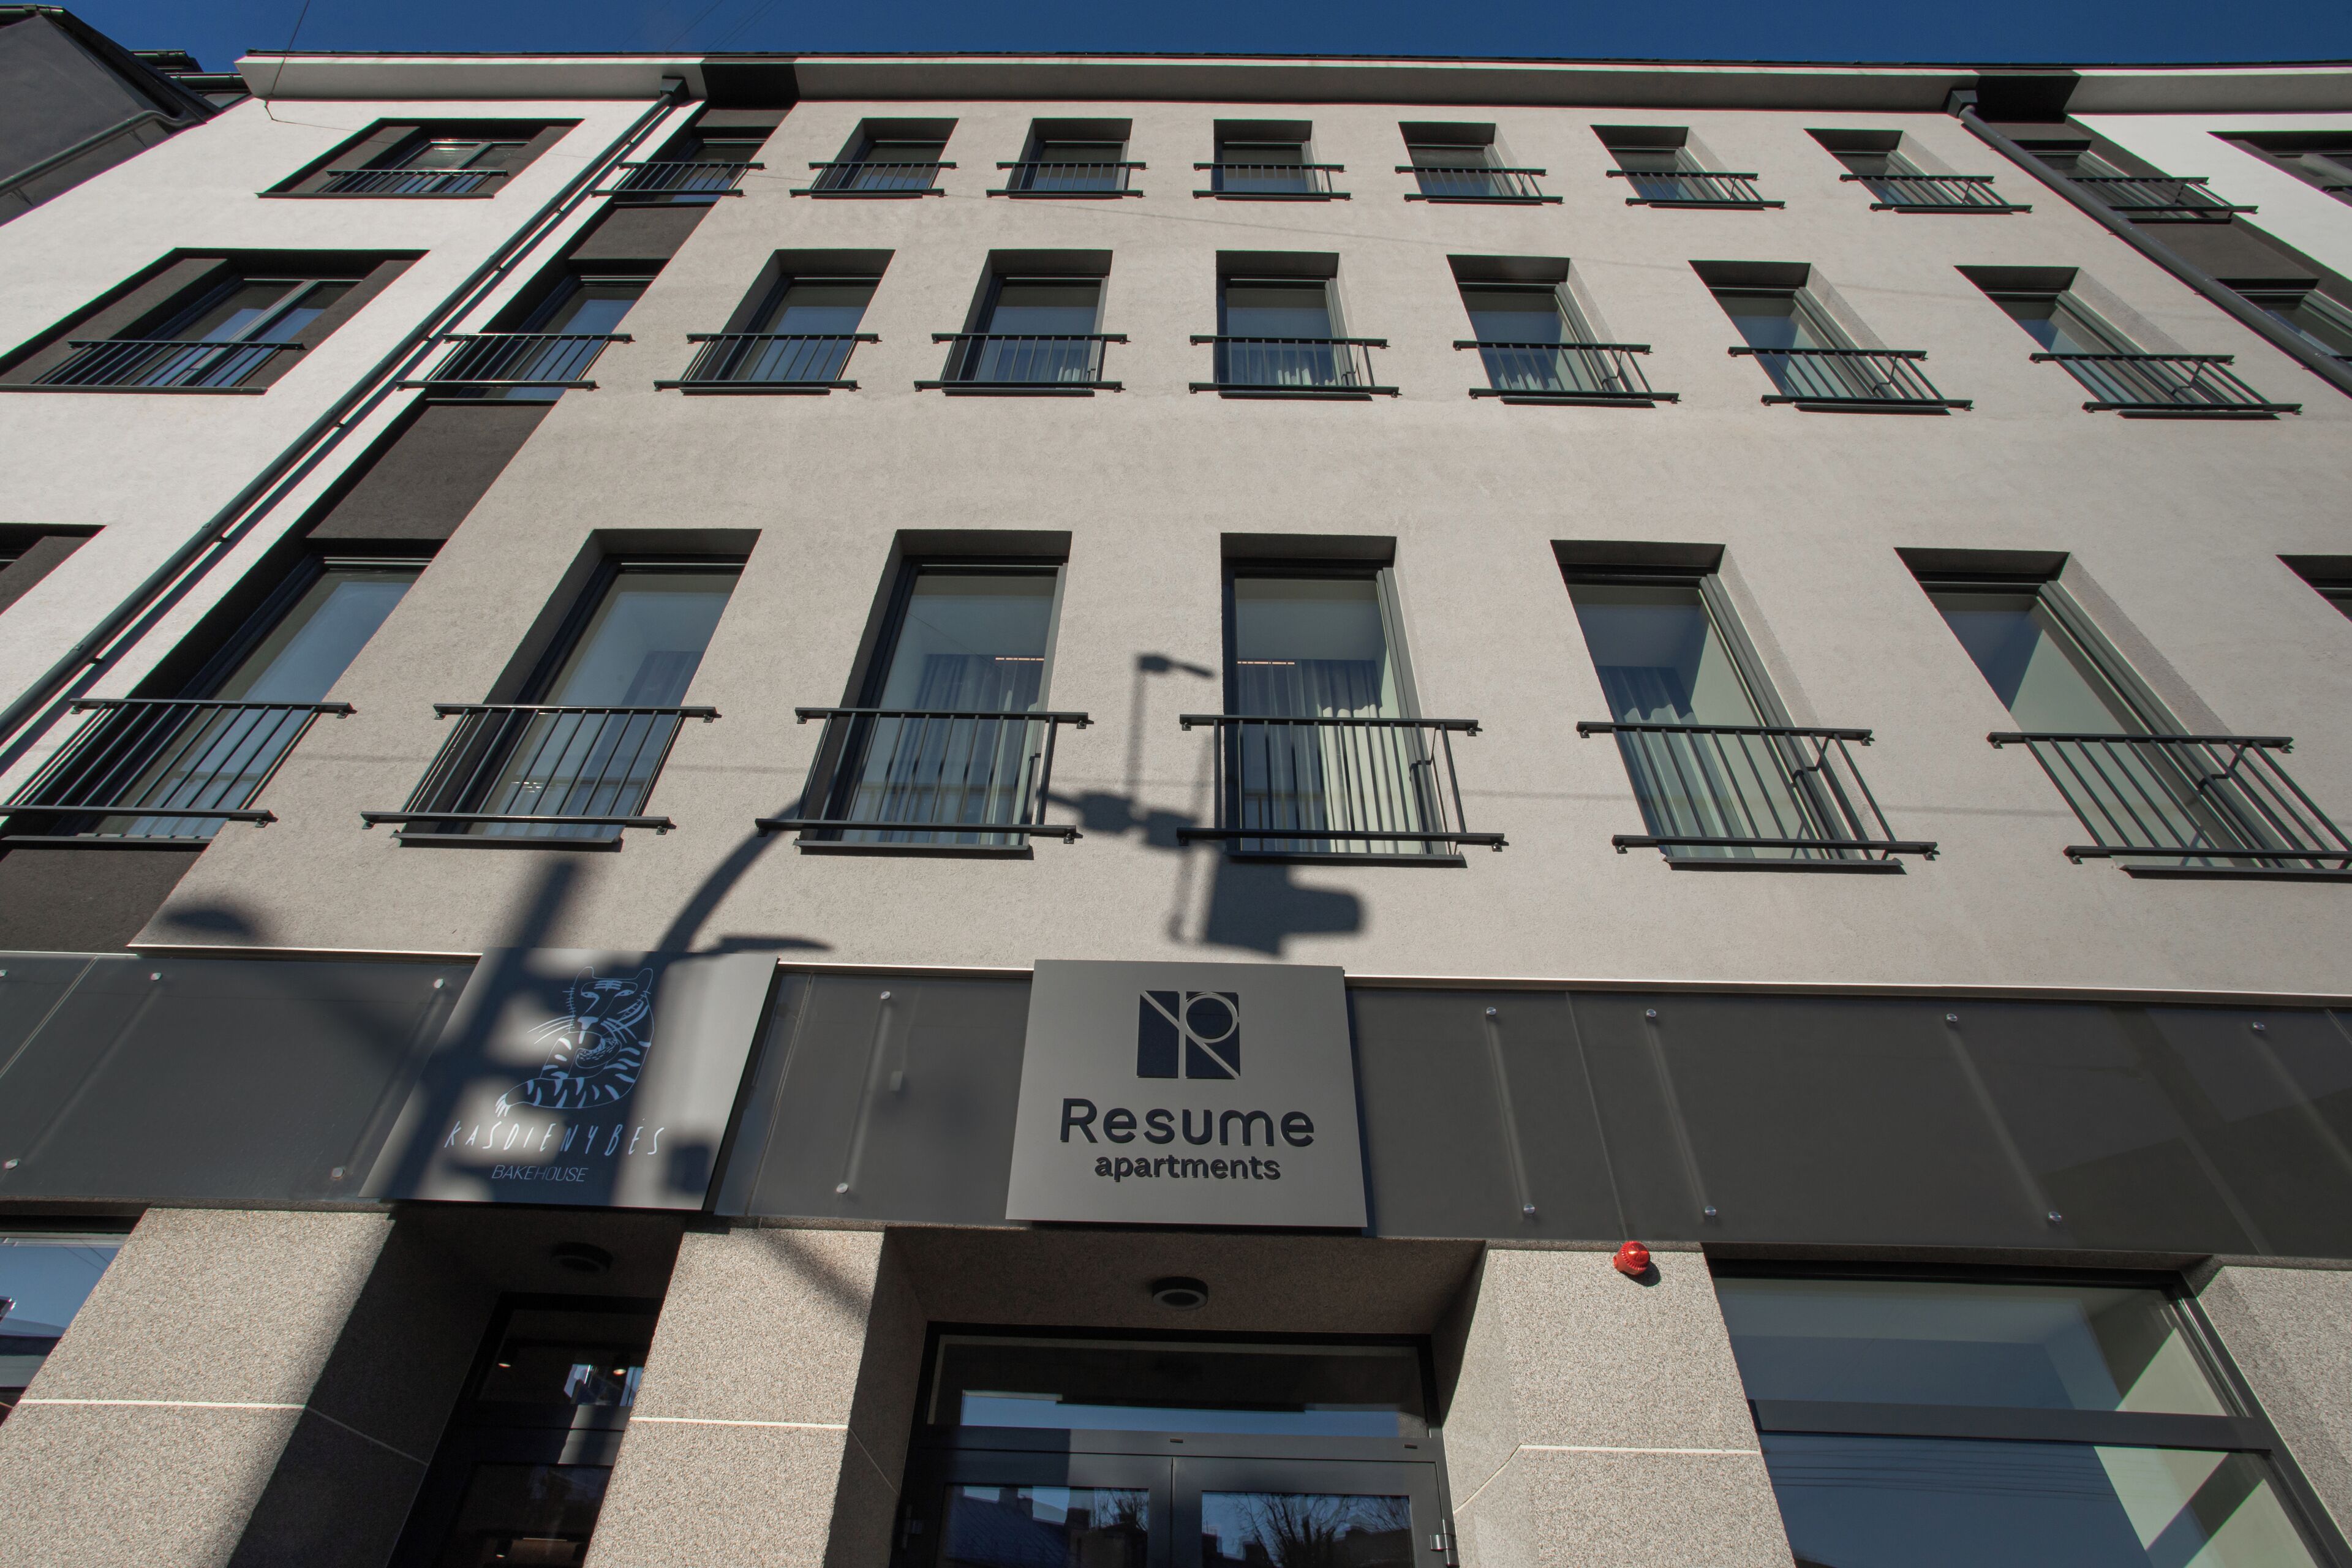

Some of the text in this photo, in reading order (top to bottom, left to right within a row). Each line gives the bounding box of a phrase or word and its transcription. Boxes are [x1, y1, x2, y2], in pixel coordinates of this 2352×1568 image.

[1060, 1098, 1314, 1147] Resume
[492, 1164, 589, 1182] BAKEHOUSE
[1095, 1155, 1281, 1182] apartments
